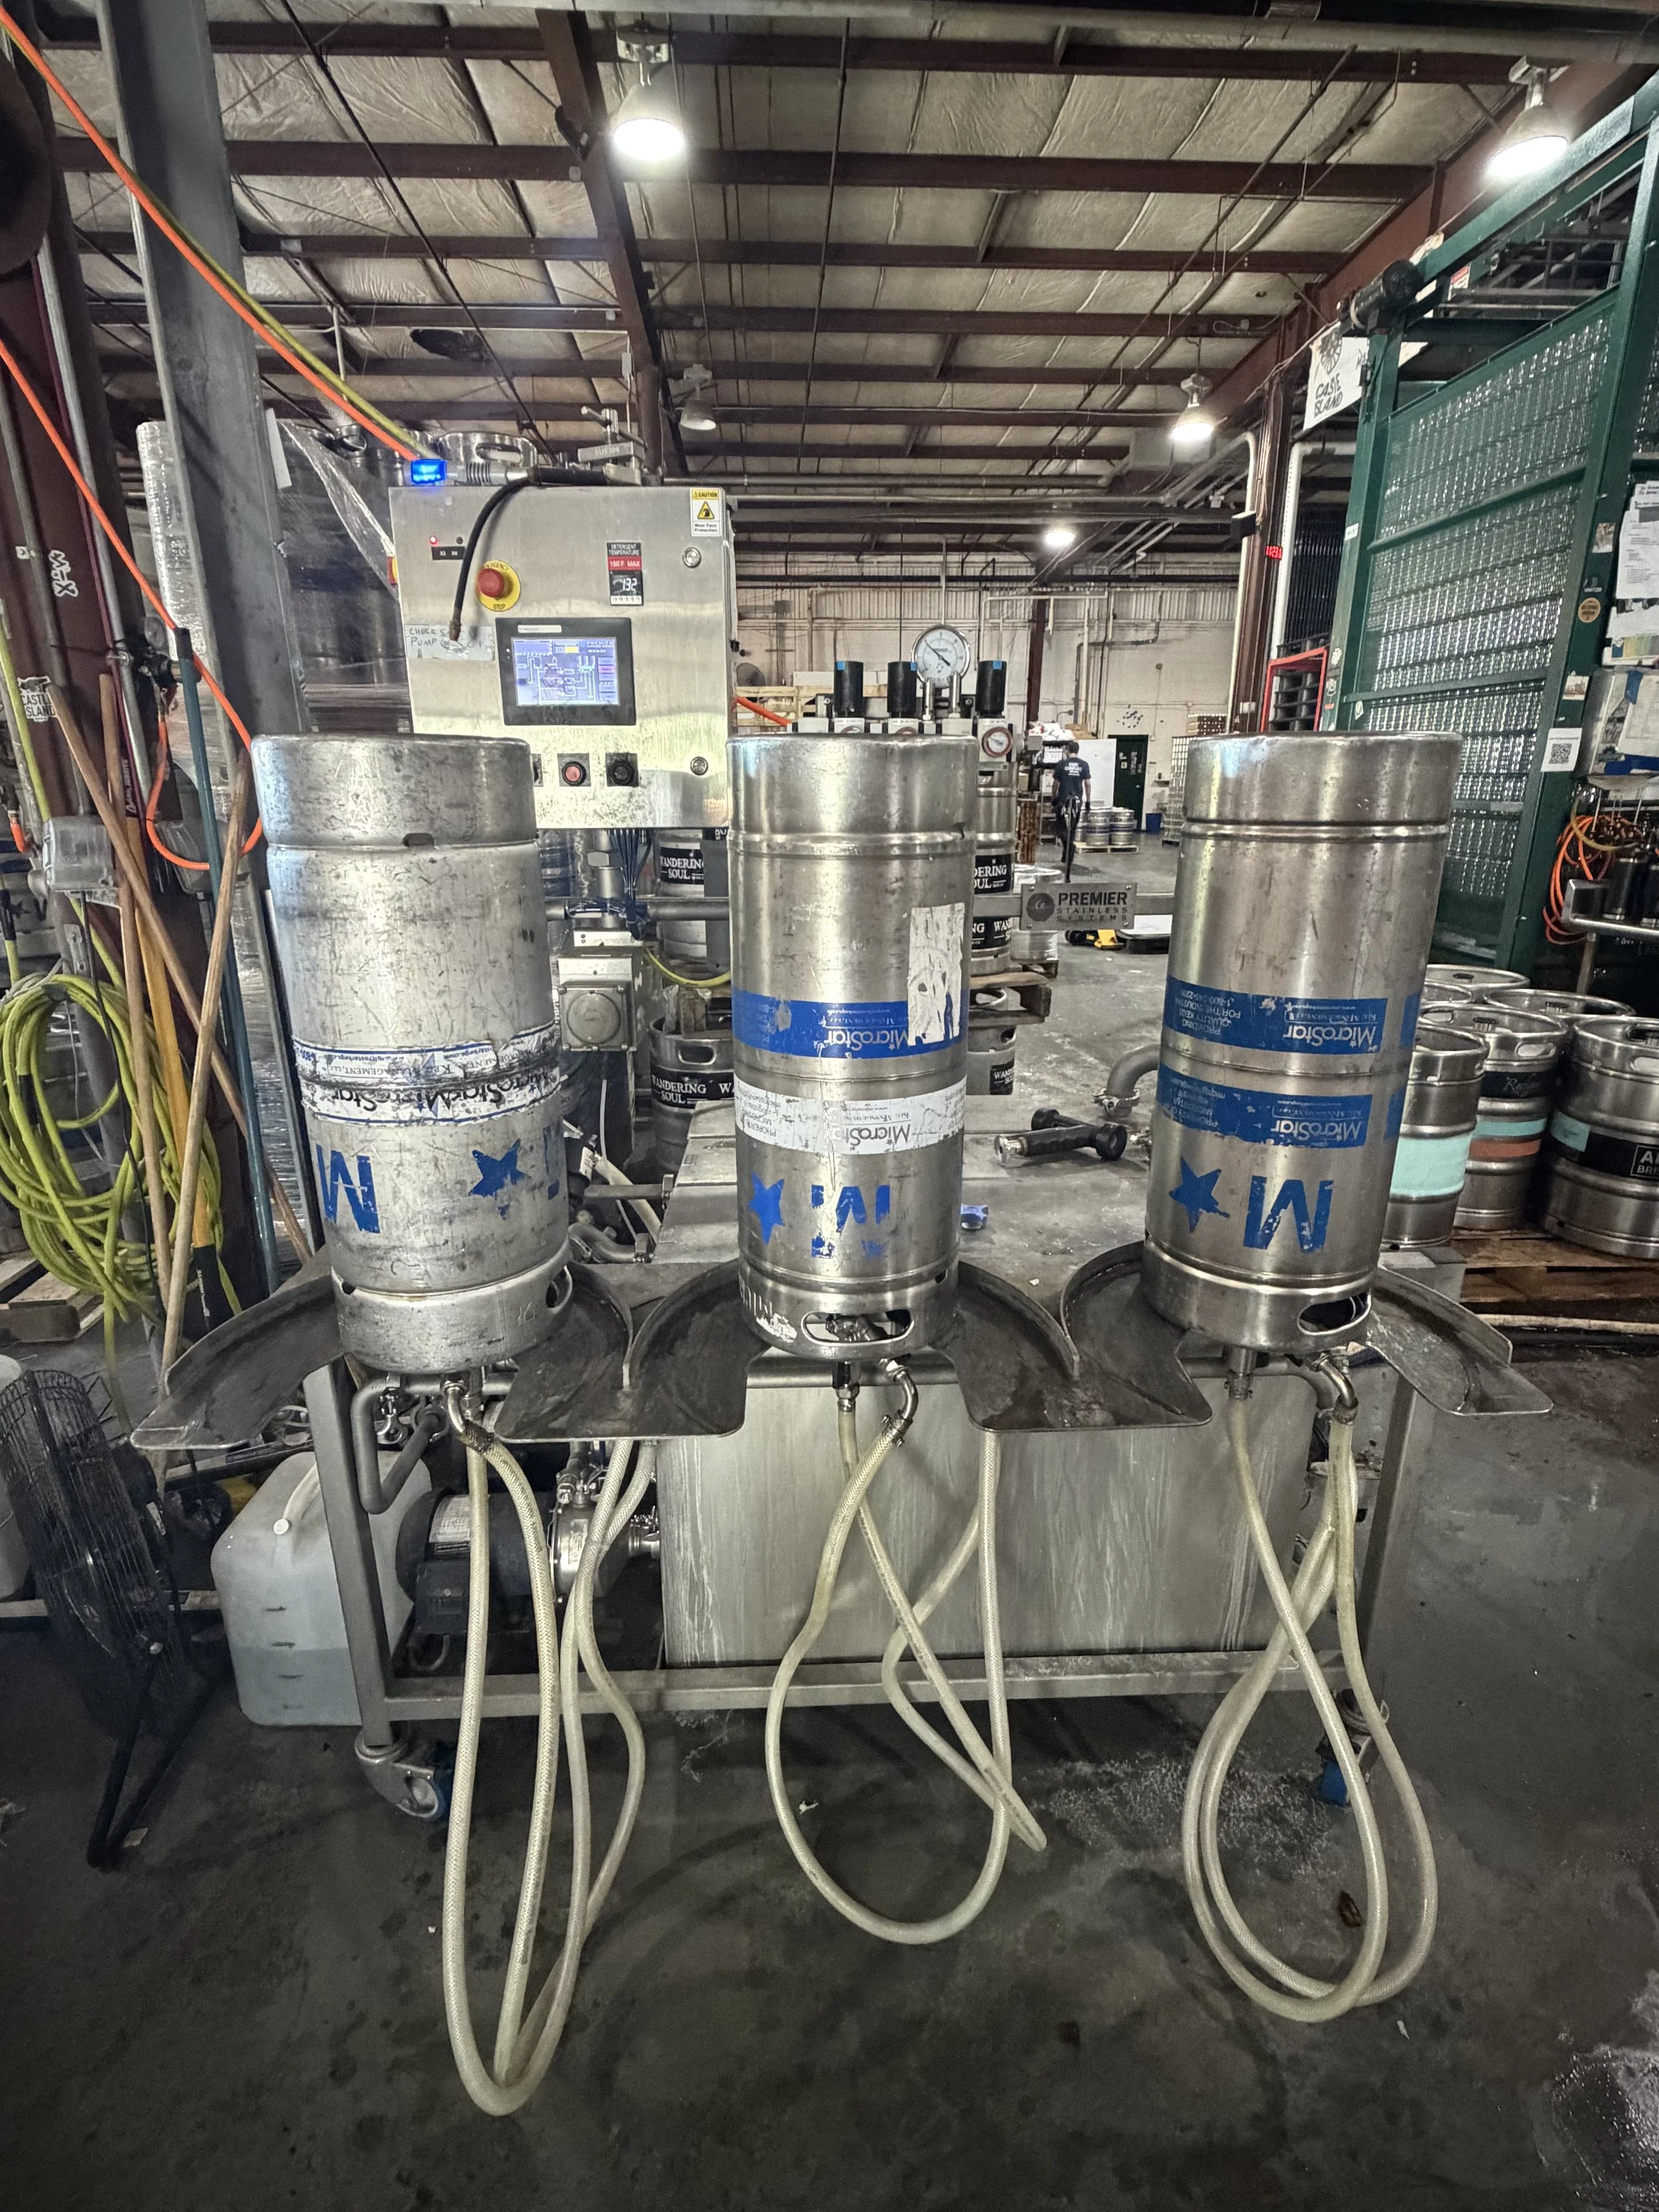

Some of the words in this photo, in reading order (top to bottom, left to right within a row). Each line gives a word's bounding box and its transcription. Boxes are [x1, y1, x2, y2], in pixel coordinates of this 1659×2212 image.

[626, 559, 640, 568] MAX
[411, 638, 437, 646] PUMP
[26, 705, 56, 717] SLAND
[668, 868, 691, 879] SOUL
[1058, 892, 1127, 906] PREMIER
[1205, 1005, 1221, 1015] THE
[1222, 1009, 1241, 1019] FOR
[1194, 1014, 1230, 1027] QUALITY
[824, 1029, 908, 1051] MicroStar
[1283, 1025, 1376, 1048] MicroStar
[661, 1090, 685, 1104] SOUL
[1270, 1120, 1363, 1142] MicroStar
